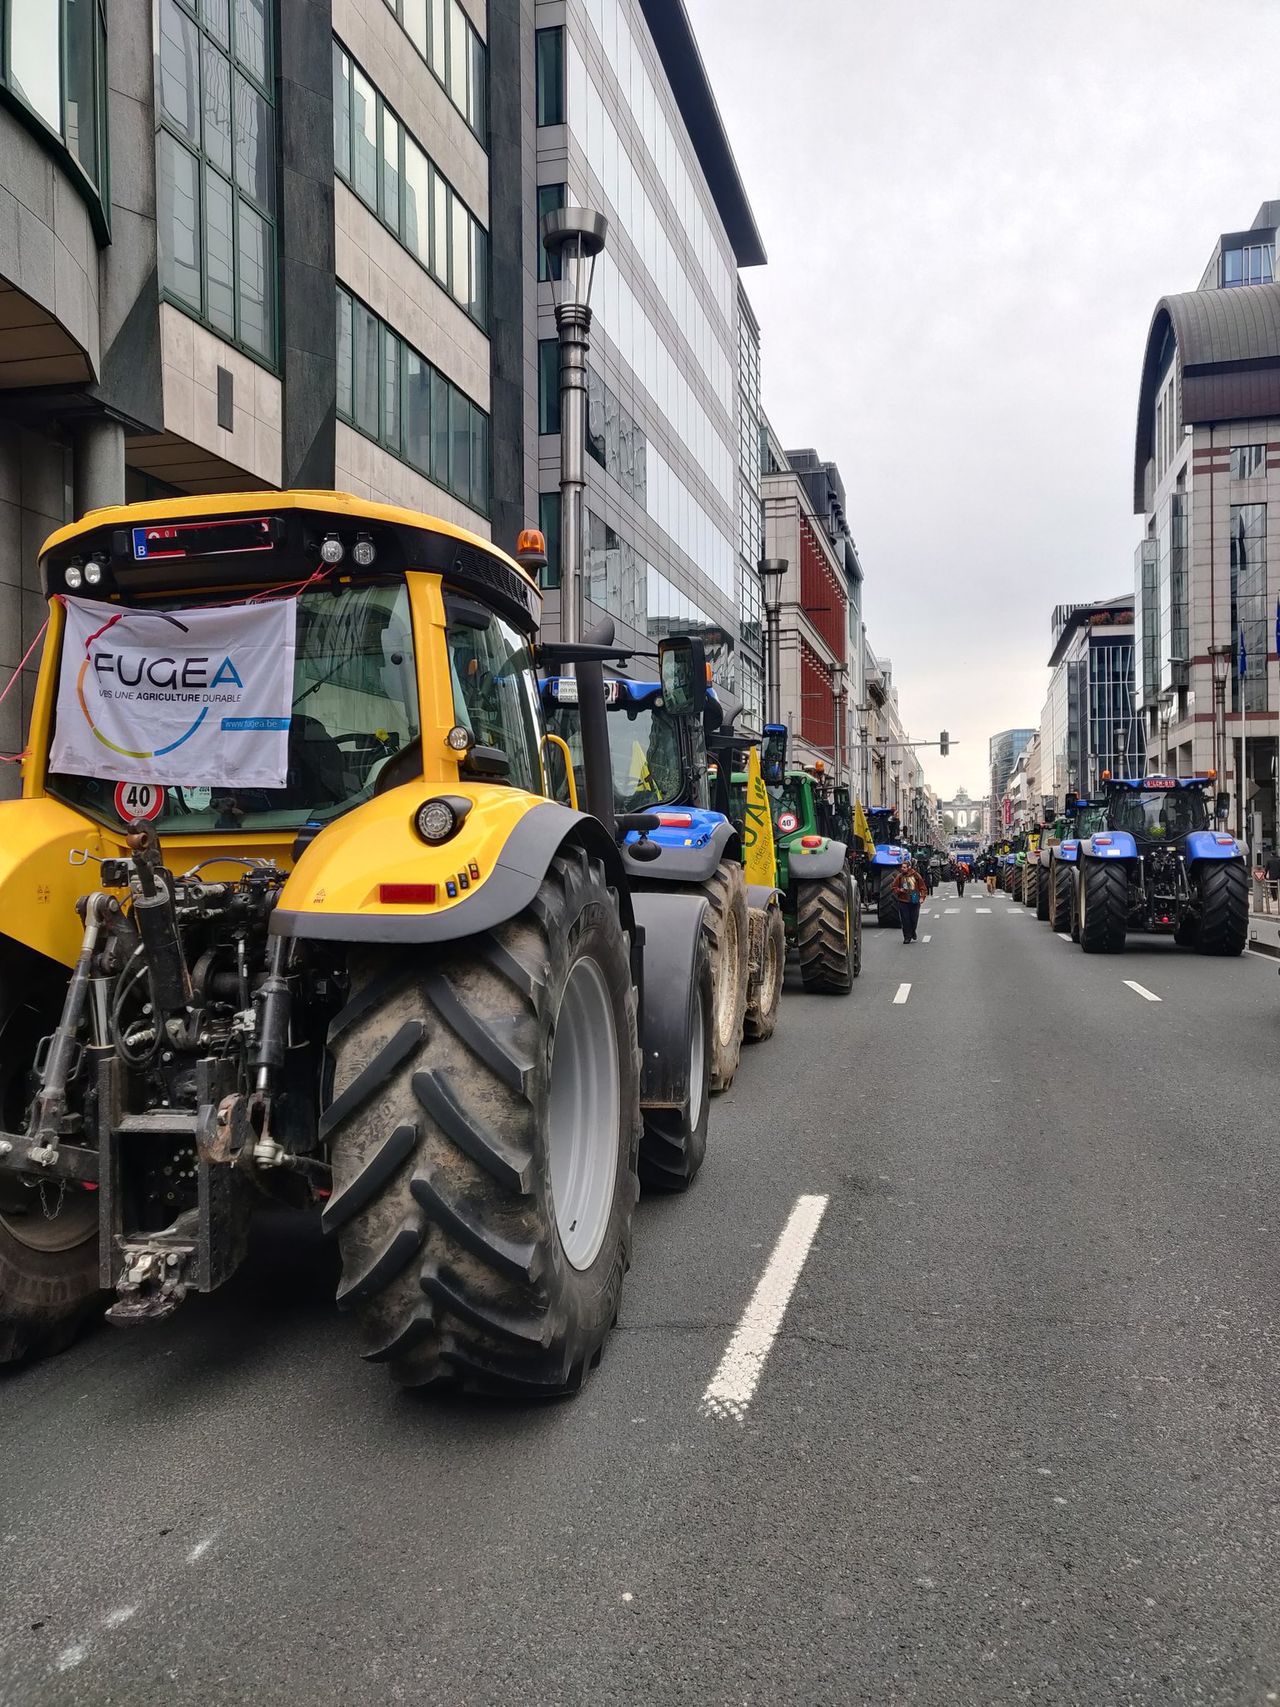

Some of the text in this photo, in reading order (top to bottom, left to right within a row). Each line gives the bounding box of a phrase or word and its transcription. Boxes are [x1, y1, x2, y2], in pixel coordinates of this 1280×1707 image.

[138, 546, 146, 556] B
[94, 653, 244, 690] FUGEA
[114, 690, 134, 700] UNE
[135, 692, 200, 702] AGRICULTURE
[202, 694, 241, 703] DURABLE
[225, 718, 278, 730] www.fugea.be
[126, 785, 150, 807] 40
